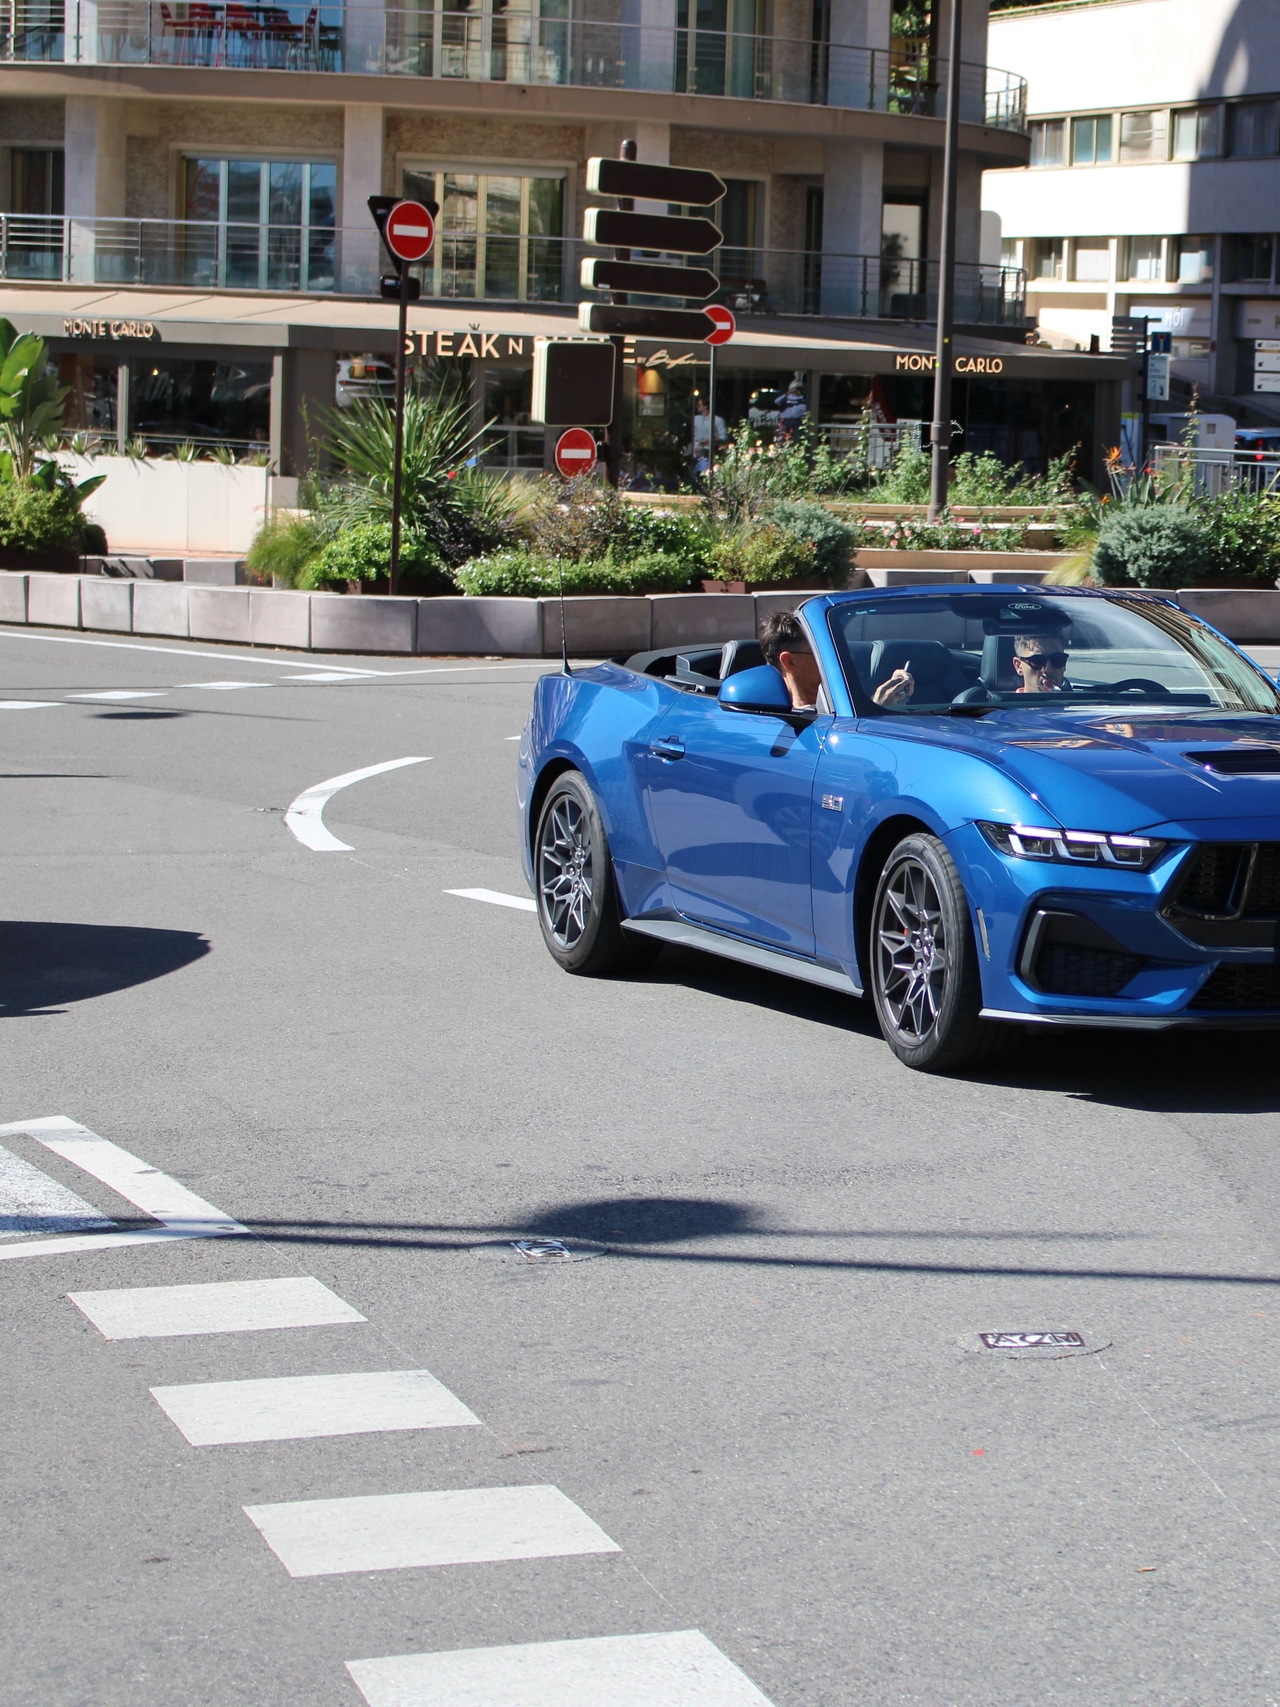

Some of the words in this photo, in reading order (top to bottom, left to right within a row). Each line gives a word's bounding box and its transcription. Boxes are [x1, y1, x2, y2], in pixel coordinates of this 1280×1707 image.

[63, 319, 107, 336] MONTE
[109, 321, 154, 338] CARLO
[404, 331, 501, 358] STEAK
[955, 357, 1003, 373] CARLO
